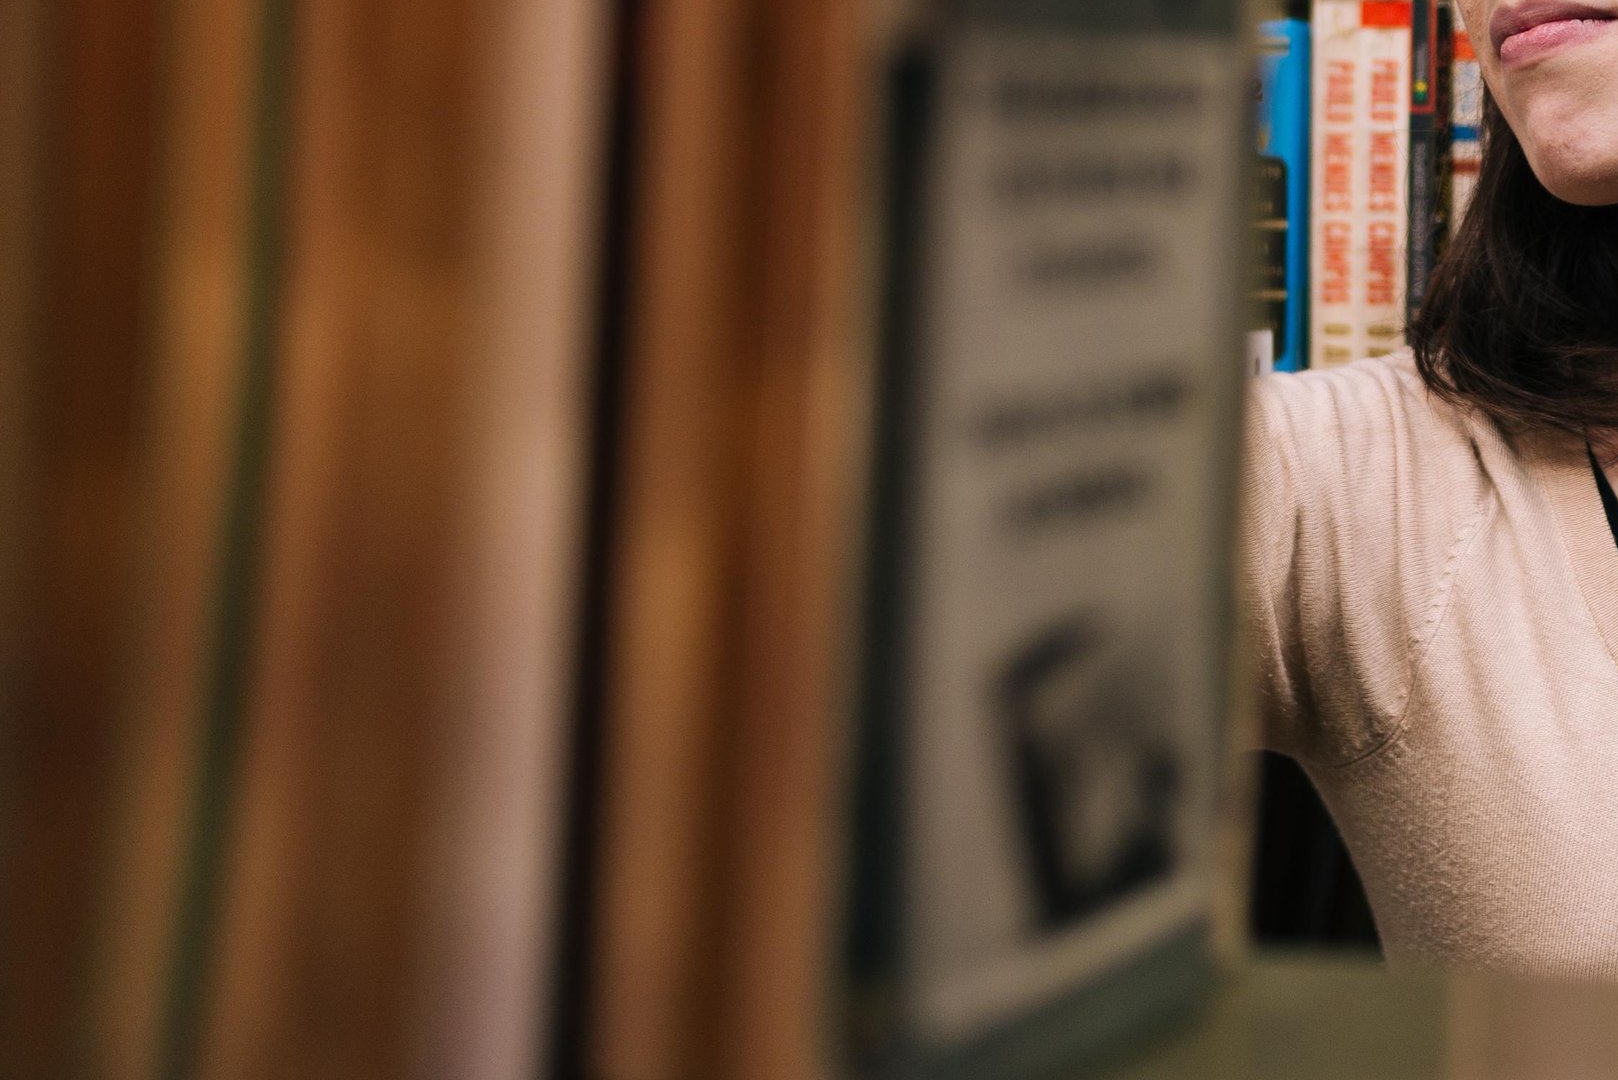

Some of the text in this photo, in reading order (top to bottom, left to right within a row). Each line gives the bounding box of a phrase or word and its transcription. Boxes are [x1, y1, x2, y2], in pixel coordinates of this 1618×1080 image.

[1326, 60, 1355, 123] PAULO
[1370, 59, 1399, 122] PAULO
[1324, 132, 1353, 212] MENDES
[1368, 132, 1397, 212] MENDES
[1322, 222, 1351, 305] CAMPOS
[1366, 221, 1396, 305] CAMPOS
